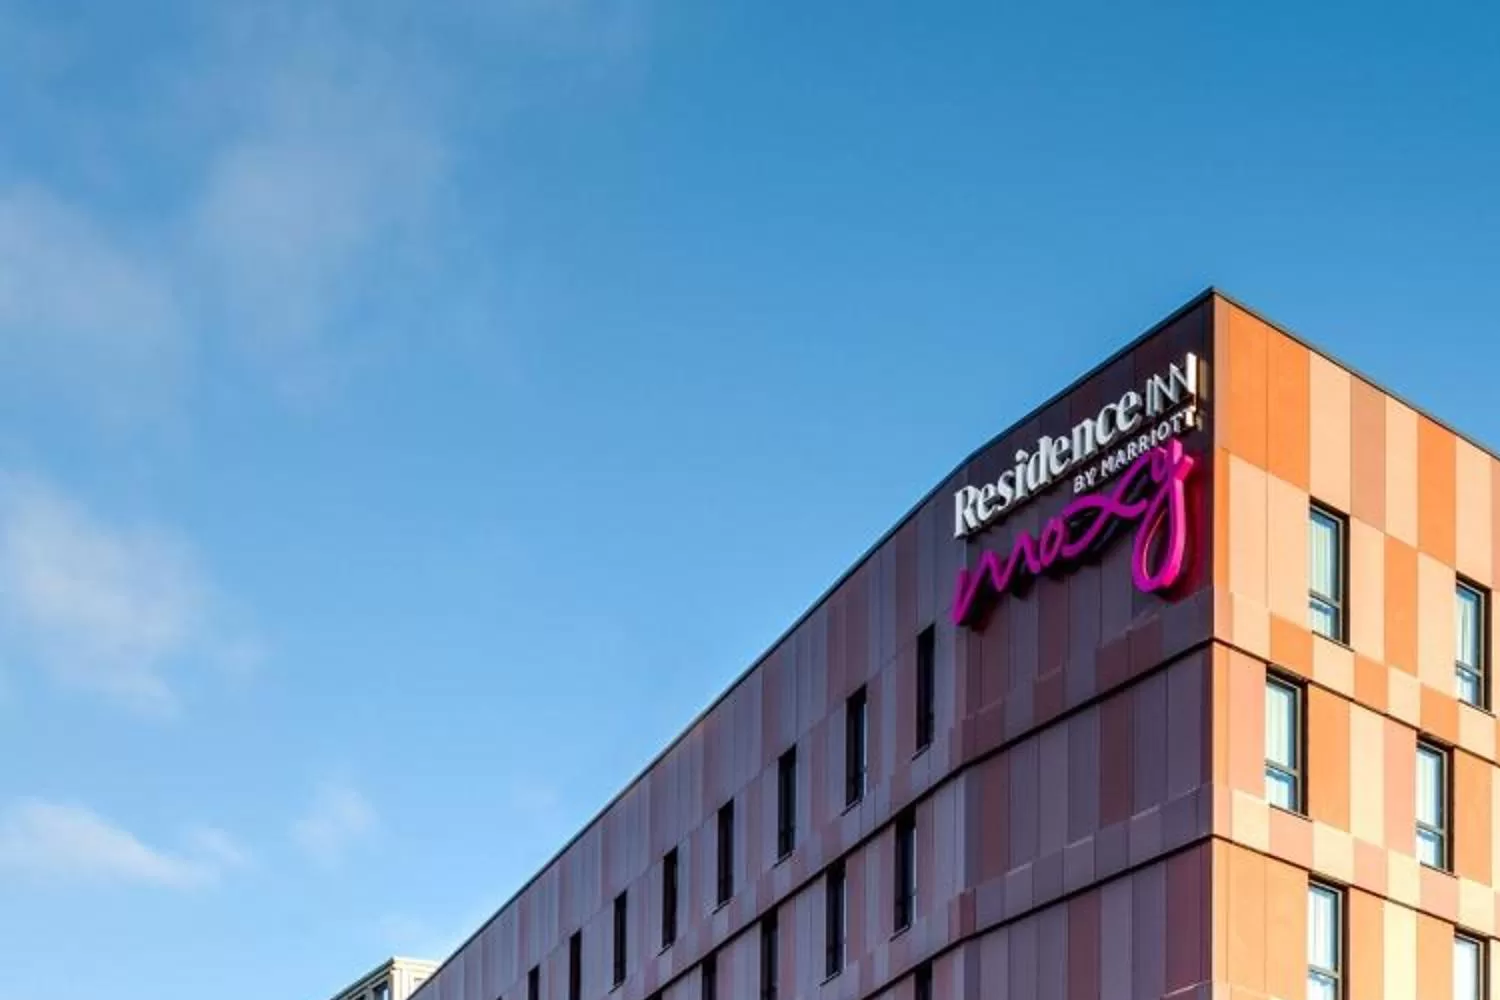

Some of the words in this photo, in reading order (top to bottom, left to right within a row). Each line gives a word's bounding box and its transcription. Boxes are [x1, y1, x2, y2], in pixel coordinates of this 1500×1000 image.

[951, 438, 1195, 626] moxy
[954, 391, 1141, 539] Residence
[1145, 352, 1197, 417] INN
[1073, 467, 1097, 493] BY
[1101, 405, 1197, 477] MARRIOTT
